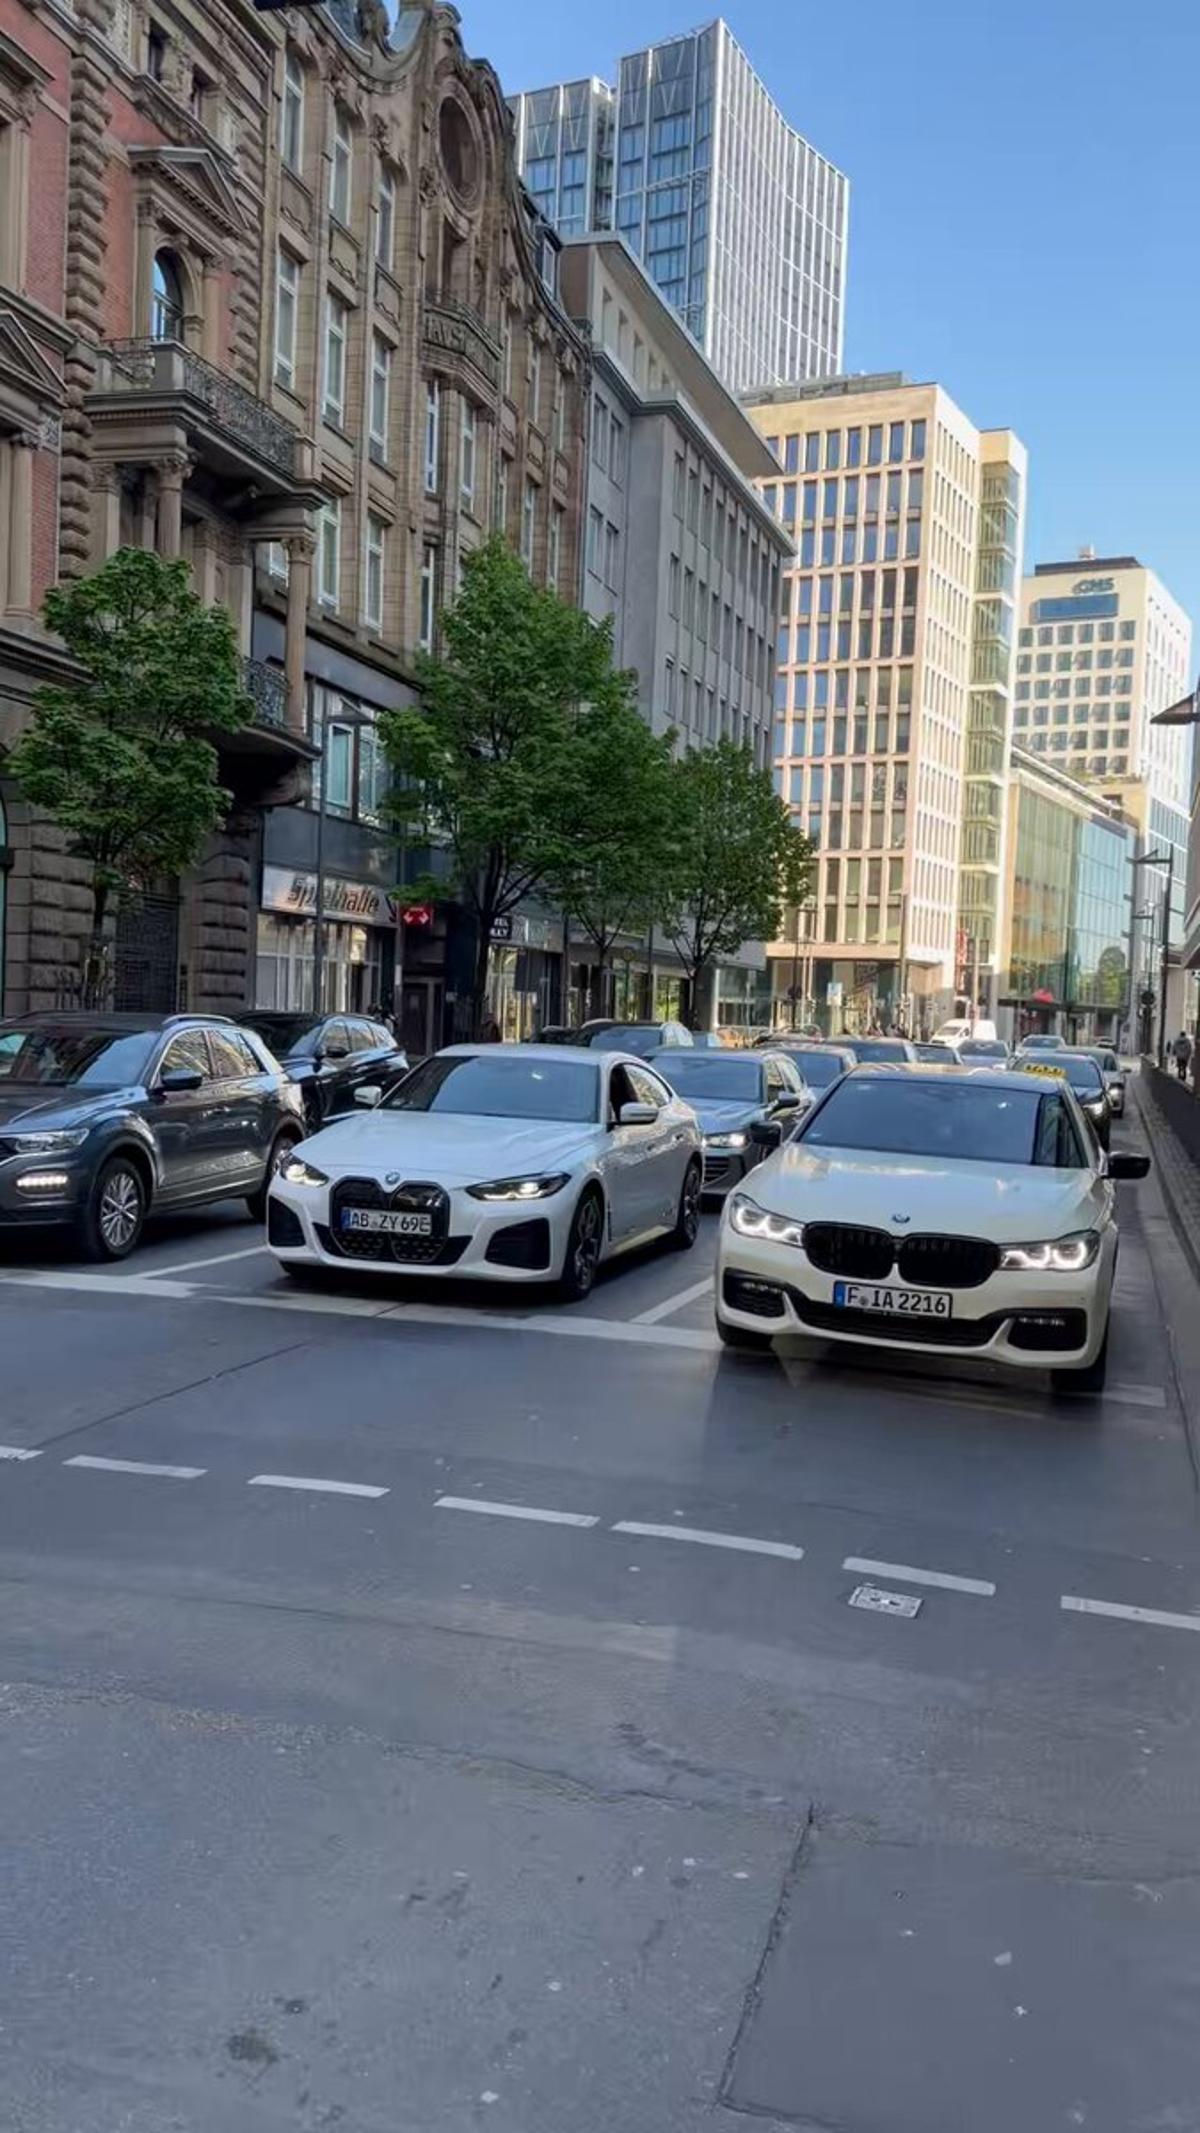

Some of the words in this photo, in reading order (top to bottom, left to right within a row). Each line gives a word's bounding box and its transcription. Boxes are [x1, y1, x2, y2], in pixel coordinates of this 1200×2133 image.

[287, 877, 380, 913] Spielhalle
[351, 1212, 369, 1228] AB
[379, 1214, 399, 1230] ZY
[847, 1286, 860, 1304] F
[871, 1289, 894, 1309] IA
[897, 1293, 946, 1314] 2216
